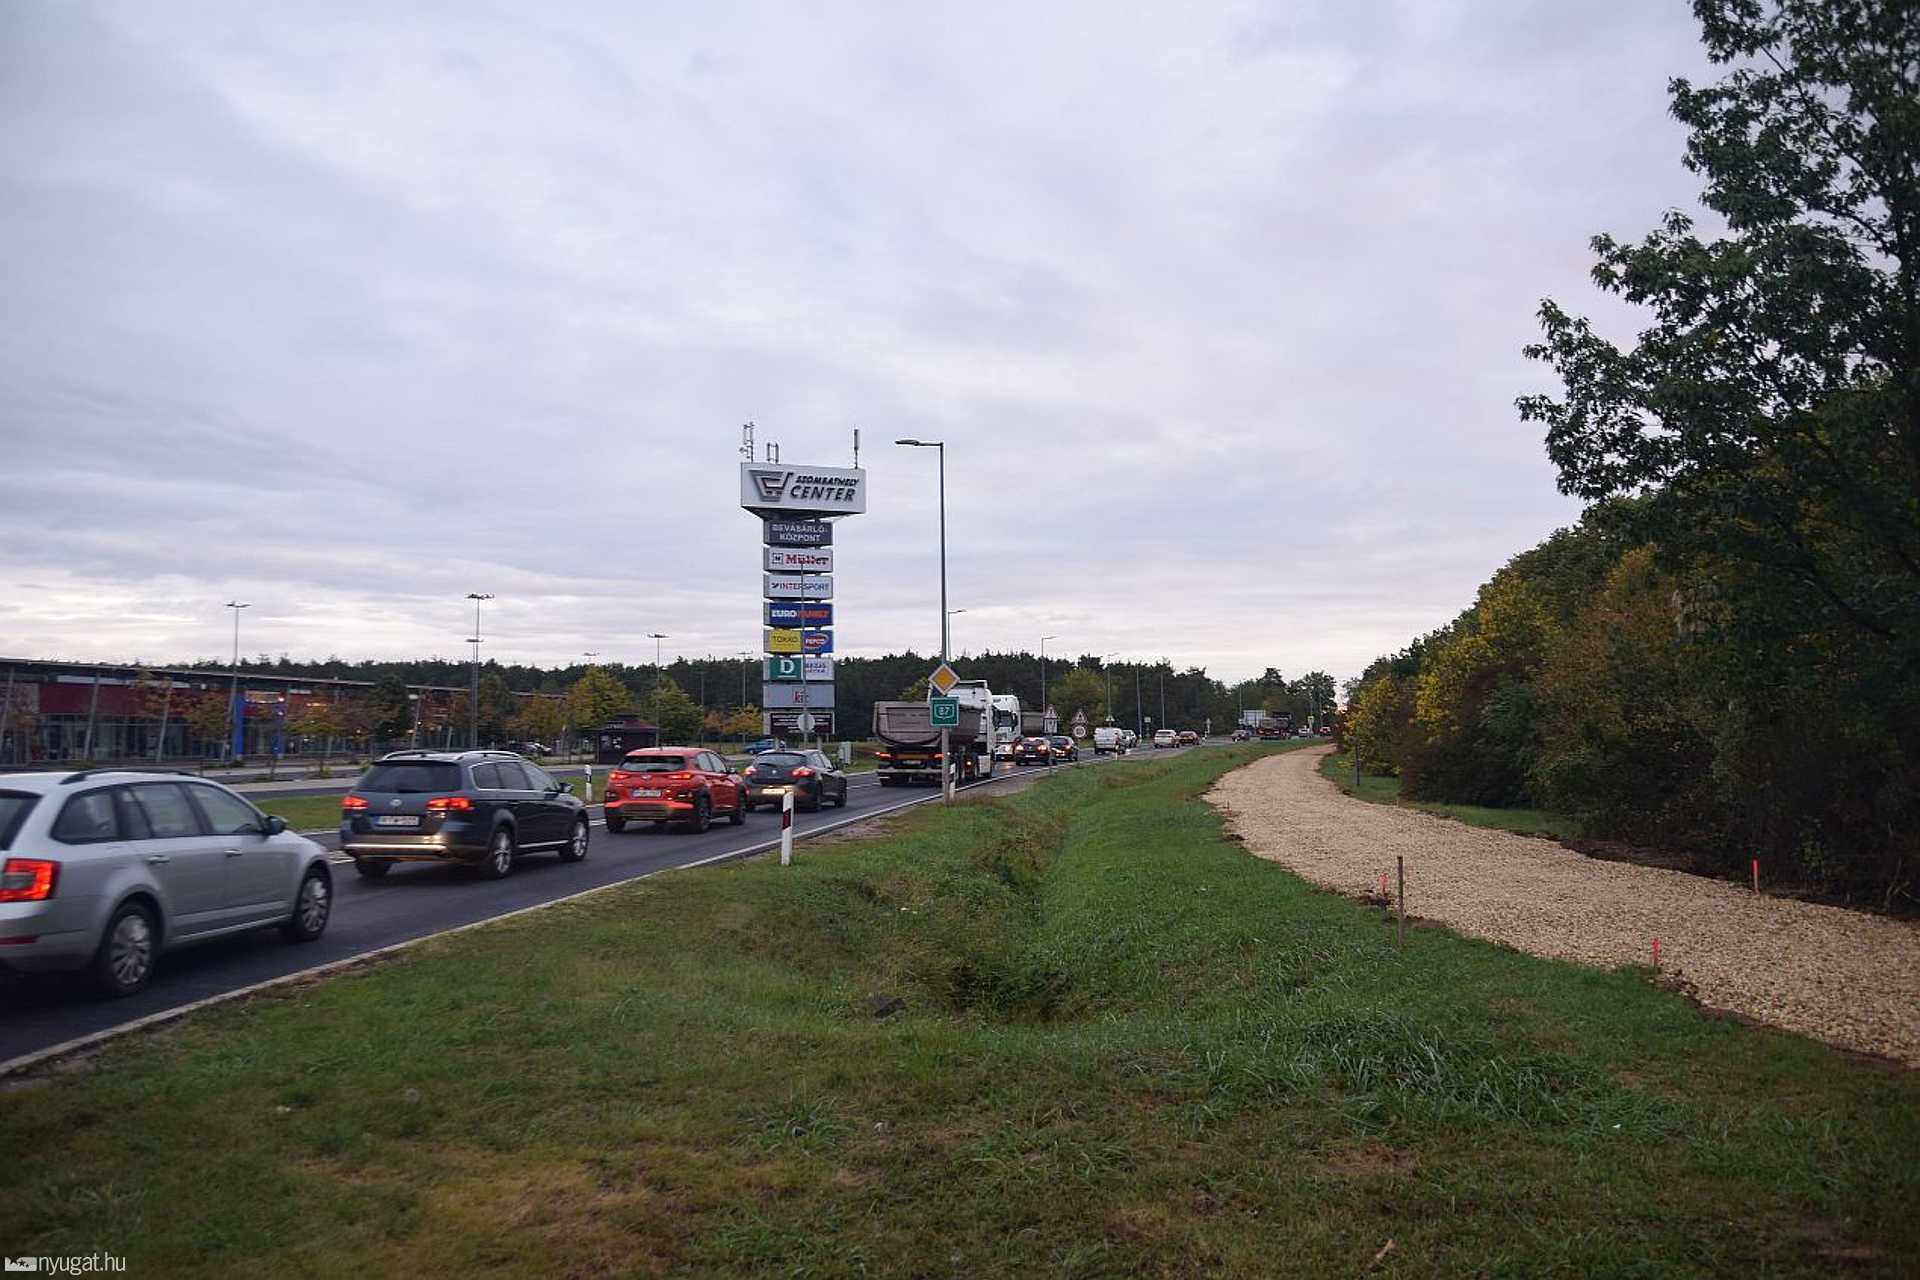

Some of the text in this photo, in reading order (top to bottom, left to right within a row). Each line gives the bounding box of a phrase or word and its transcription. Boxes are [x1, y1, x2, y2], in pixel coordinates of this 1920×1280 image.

[790, 485, 855, 501] CENTER
[780, 583, 828, 591] INTERSPORT
[780, 659, 795, 674] D
